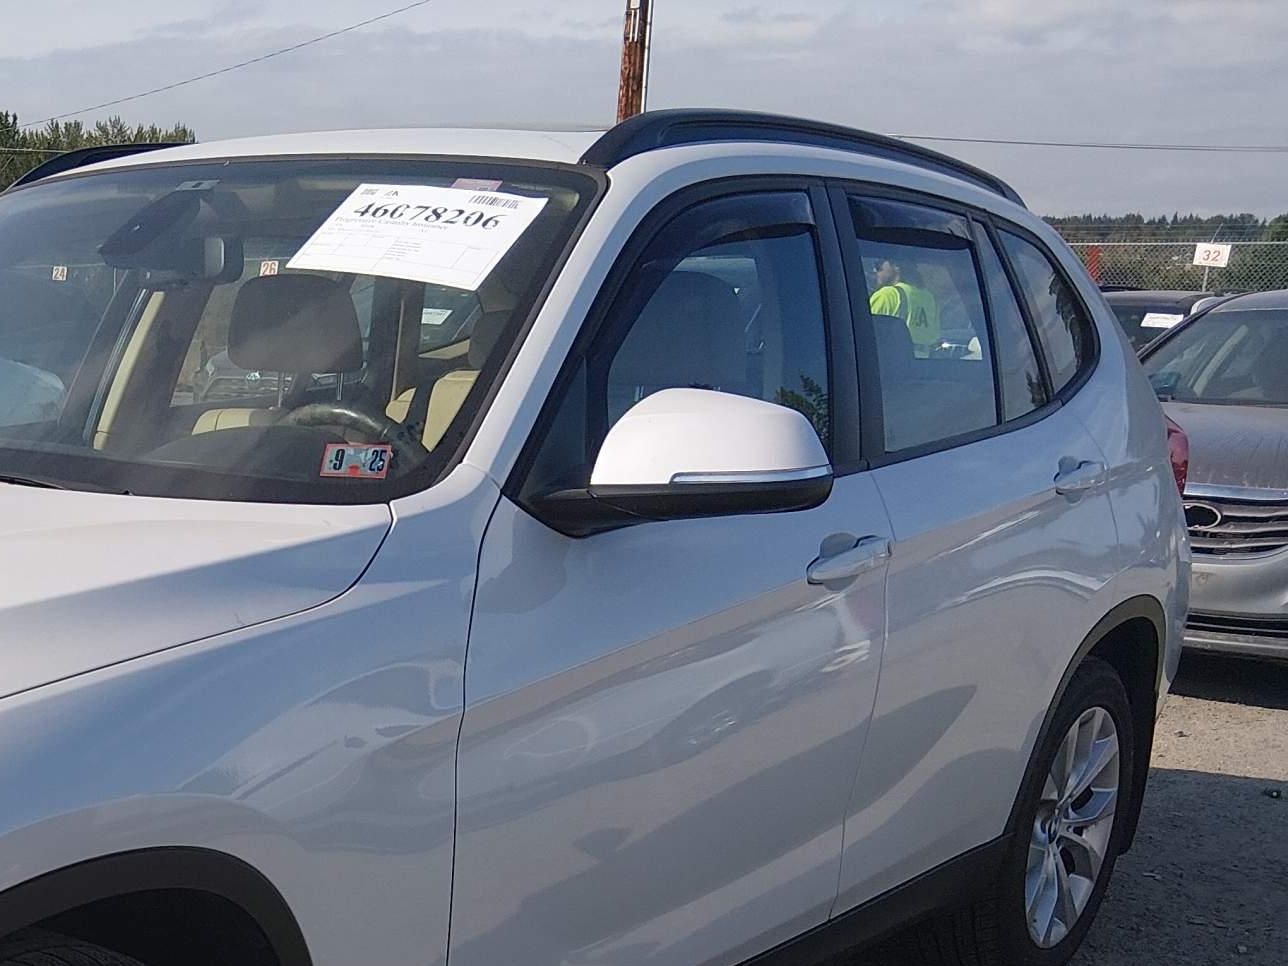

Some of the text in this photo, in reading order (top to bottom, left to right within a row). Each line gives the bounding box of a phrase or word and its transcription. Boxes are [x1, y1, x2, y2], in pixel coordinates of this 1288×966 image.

[353, 202, 509, 230] 46078206
[1203, 250, 1221, 262] 32
[262, 261, 277, 276] 26
[332, 448, 388, 472] 9 25
